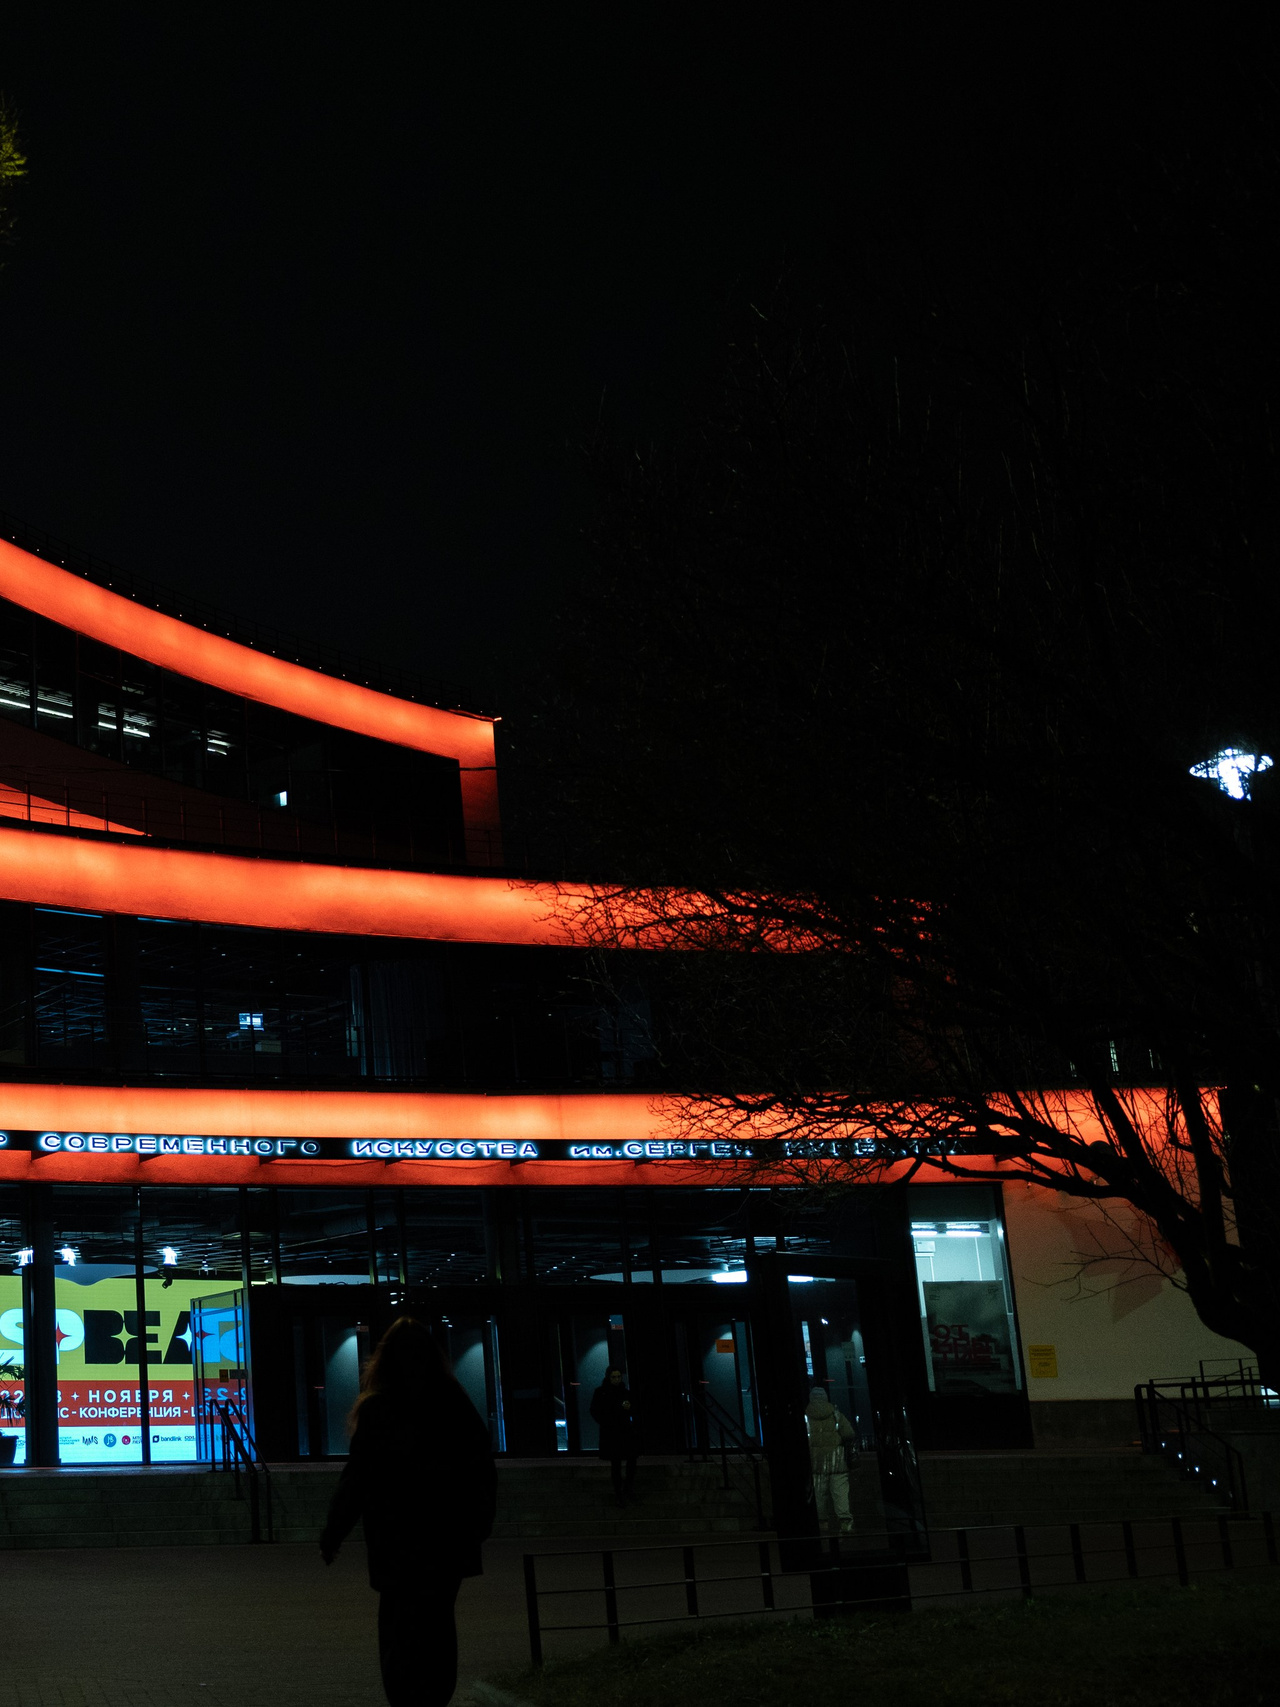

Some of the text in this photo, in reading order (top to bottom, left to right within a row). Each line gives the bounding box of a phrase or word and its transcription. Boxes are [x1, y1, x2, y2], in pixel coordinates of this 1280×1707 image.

[43, 1134, 320, 1155] СОВРЕМЕННОГО
[354, 1139, 538, 1156] ИСКУССТВА
[79, 1406, 182, 1419] КОНФЕРЕНЦИЯ
